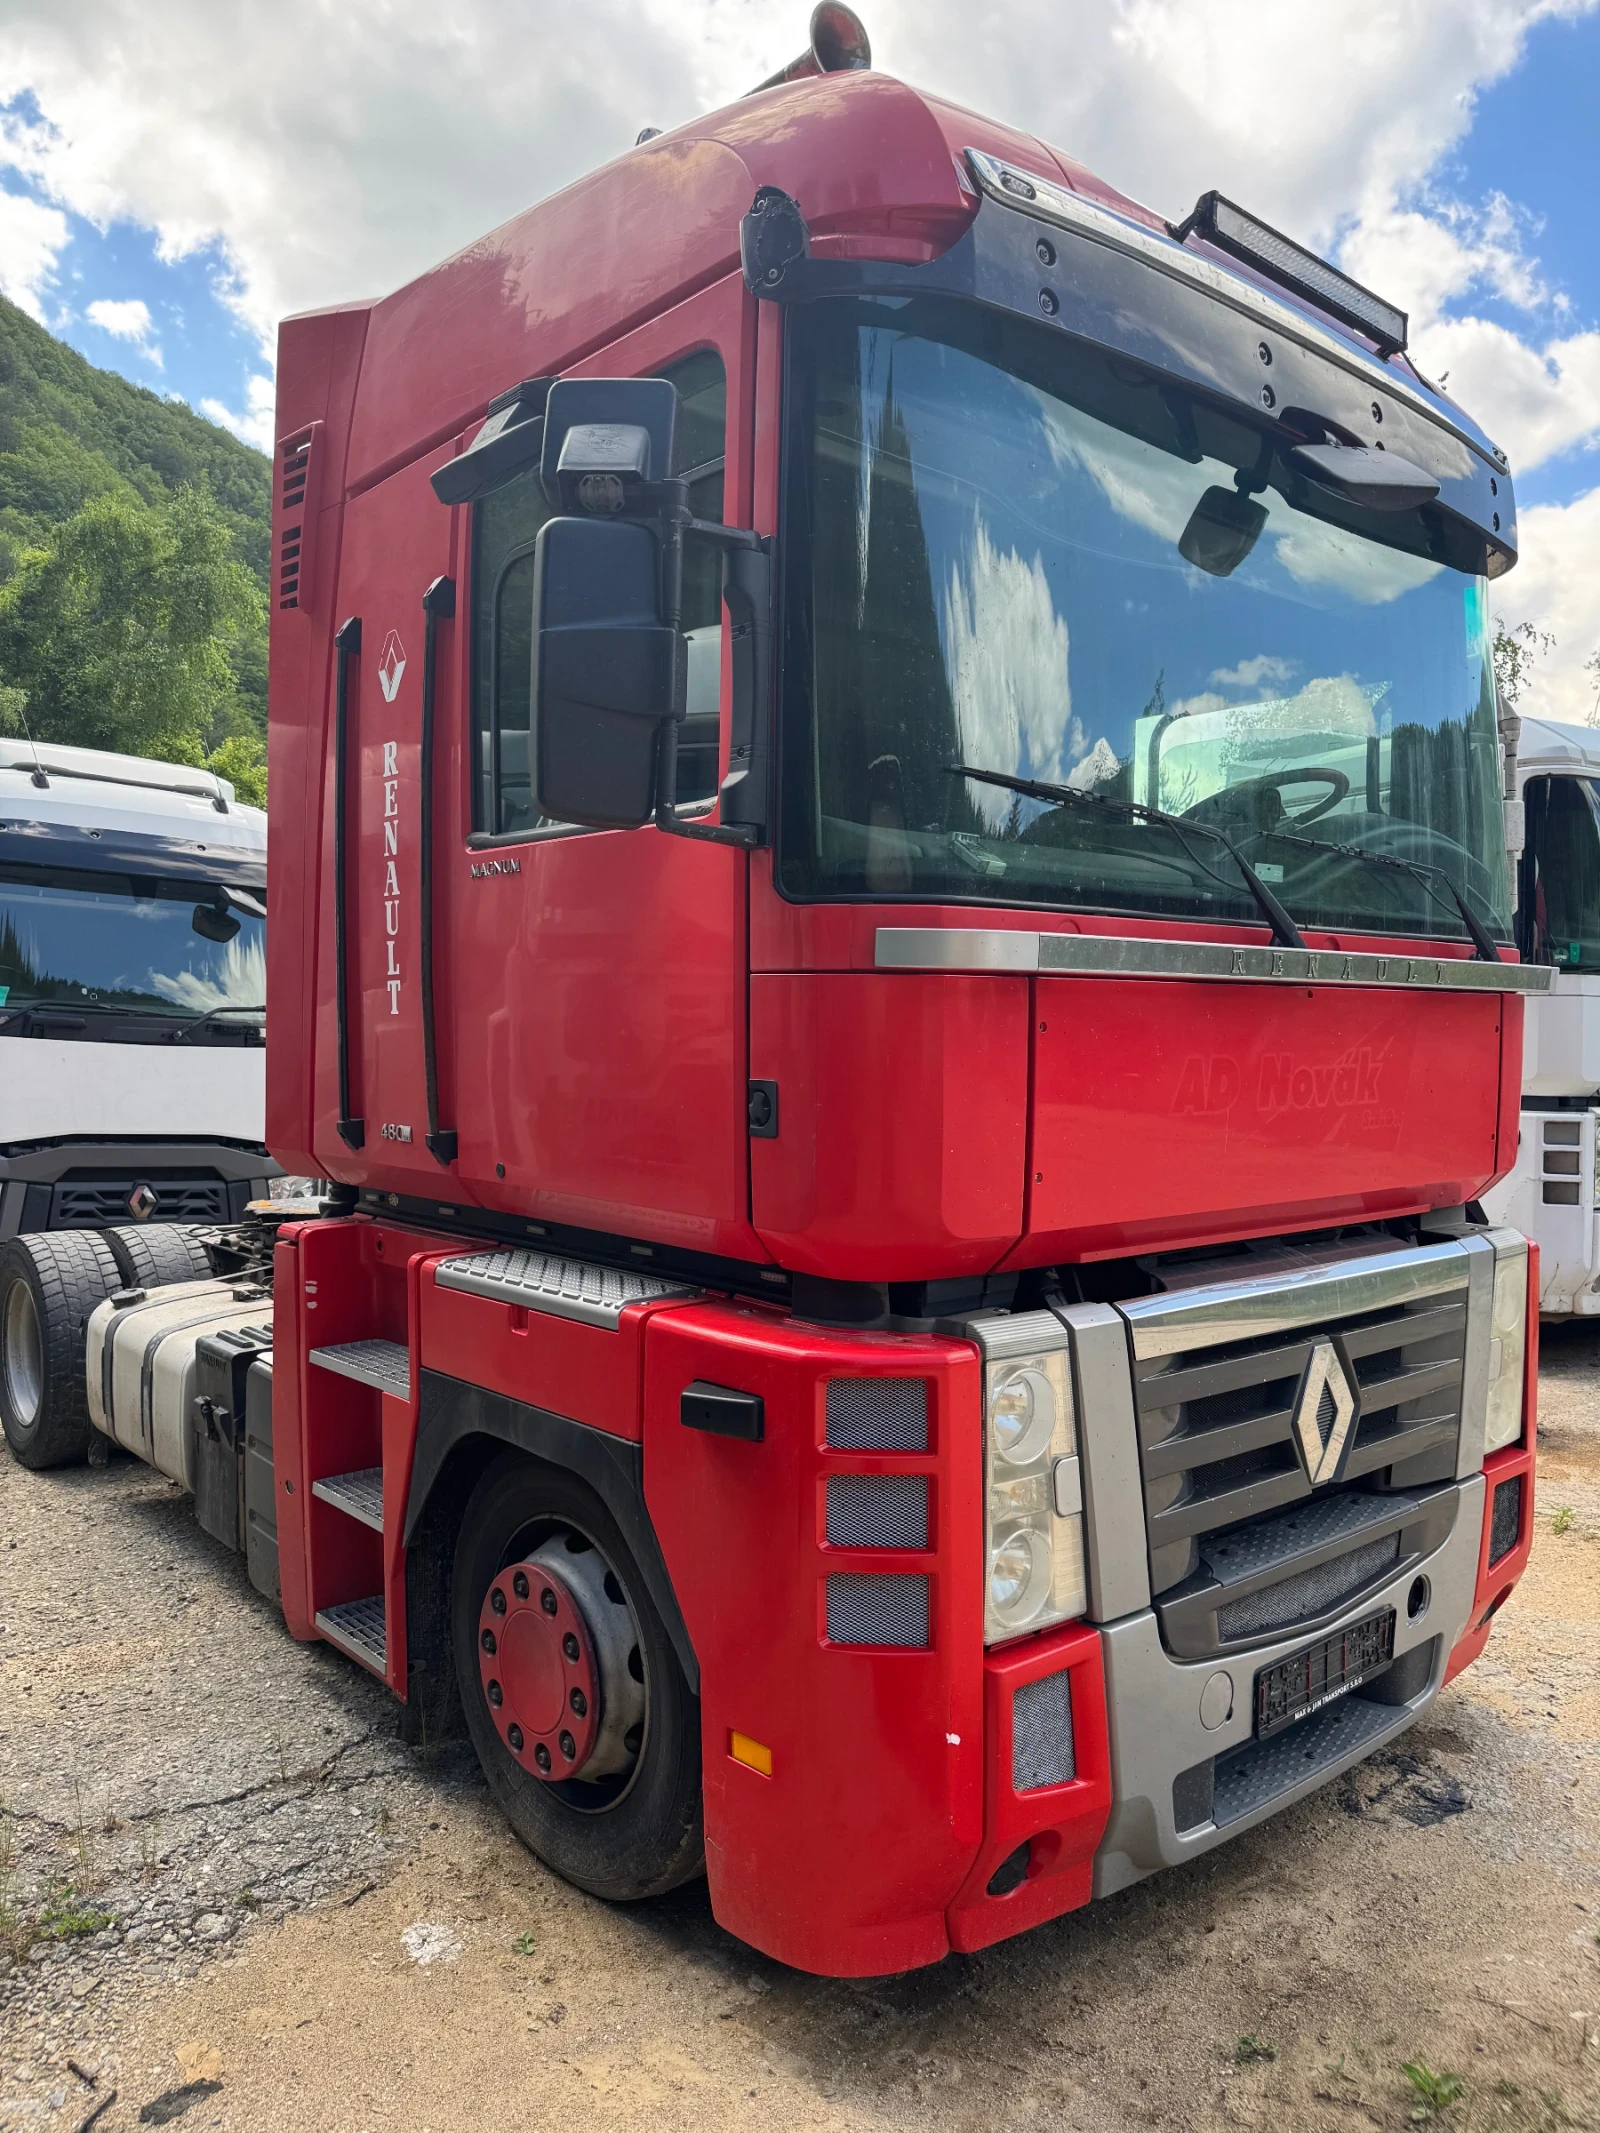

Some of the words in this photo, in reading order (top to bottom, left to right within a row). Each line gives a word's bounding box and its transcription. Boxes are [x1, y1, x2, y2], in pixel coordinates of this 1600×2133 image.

[382, 740, 401, 1015] RENAULT
[469, 857, 521, 878] MAGNUM
[1230, 949, 1448, 985] RENAULT
[1167, 1053, 1242, 1117] AD
[381, 1122, 404, 1141] 480
[1321, 1684, 1350, 1705] TRANSPORT
